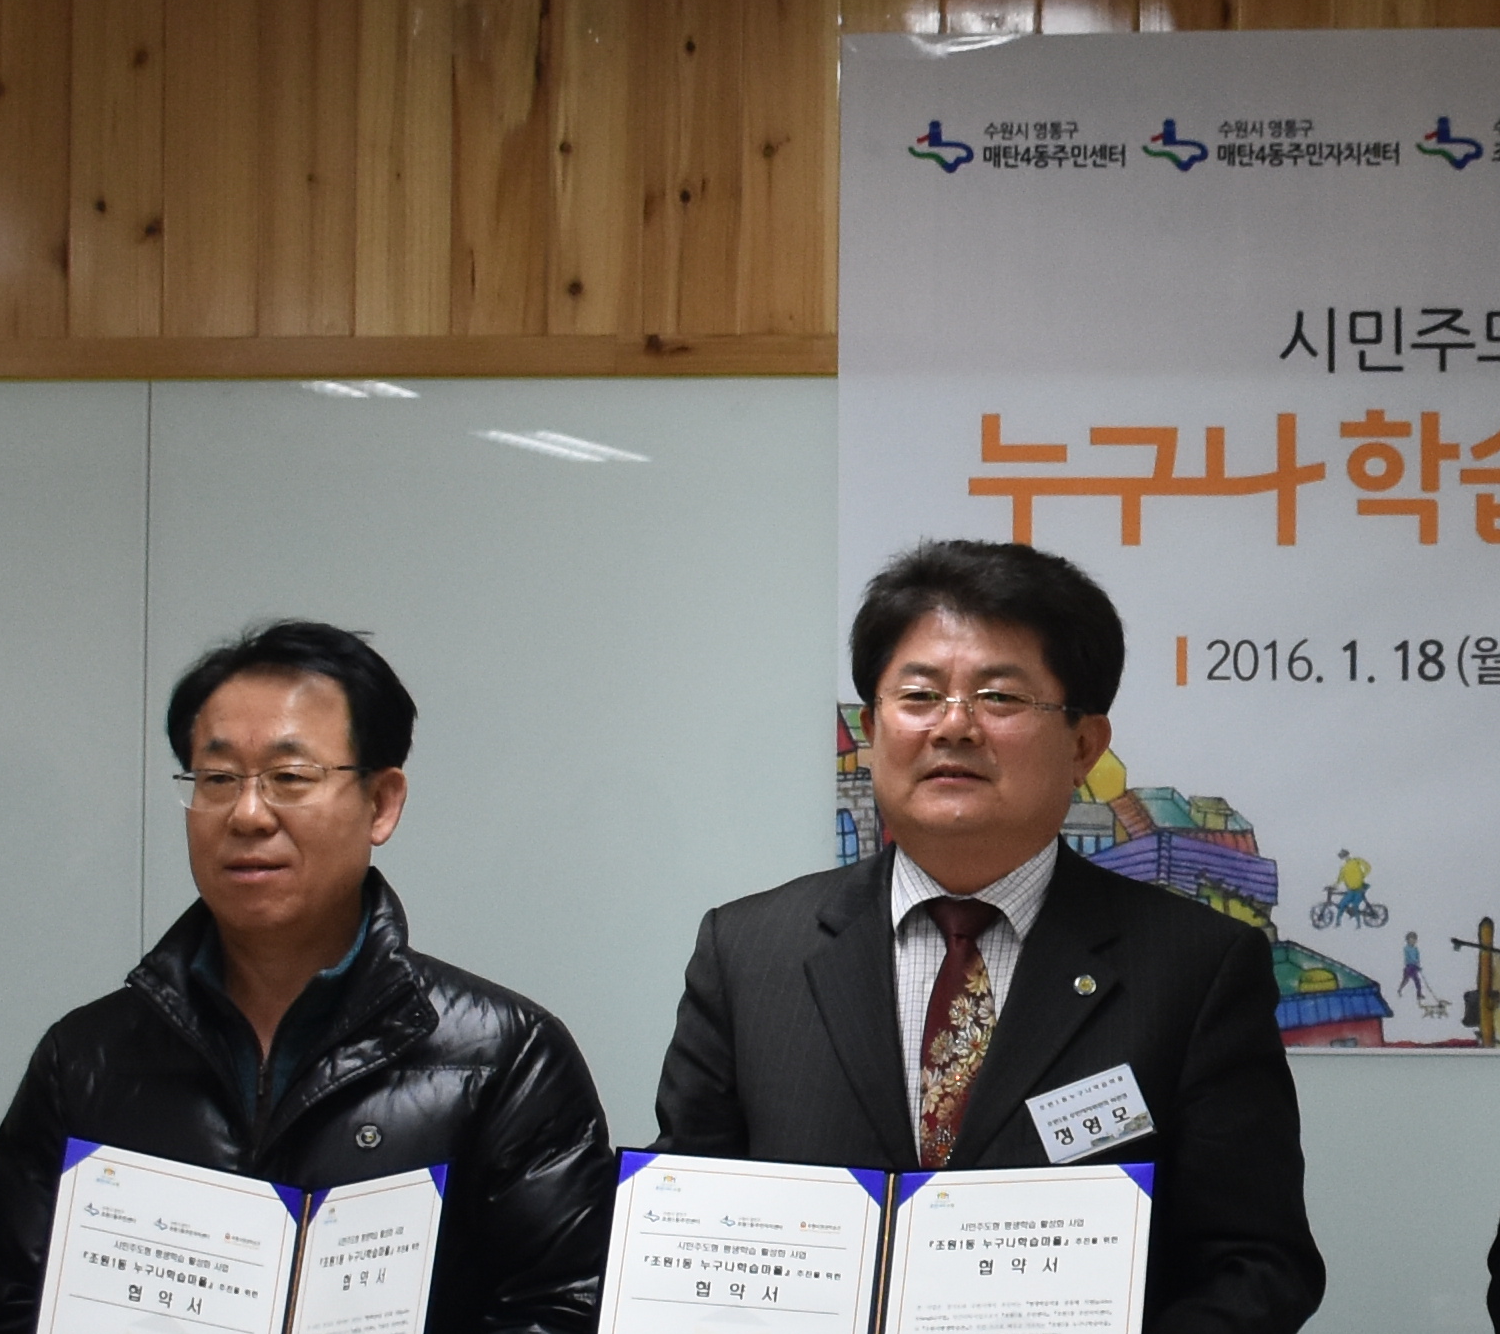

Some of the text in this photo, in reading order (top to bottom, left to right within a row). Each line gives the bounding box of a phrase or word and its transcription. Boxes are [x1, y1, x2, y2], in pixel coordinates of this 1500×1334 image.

[984, 121, 1079, 140] 수원시 영통구
[1218, 118, 1314, 138] 수원시 영통구
[982, 141, 1126, 169] 매탄4동주민센터
[1217, 140, 1400, 167] 매탄4동주민자치센터
[1206, 639, 1325, 683] 2016.
[1342, 640, 1376, 683] 1.
